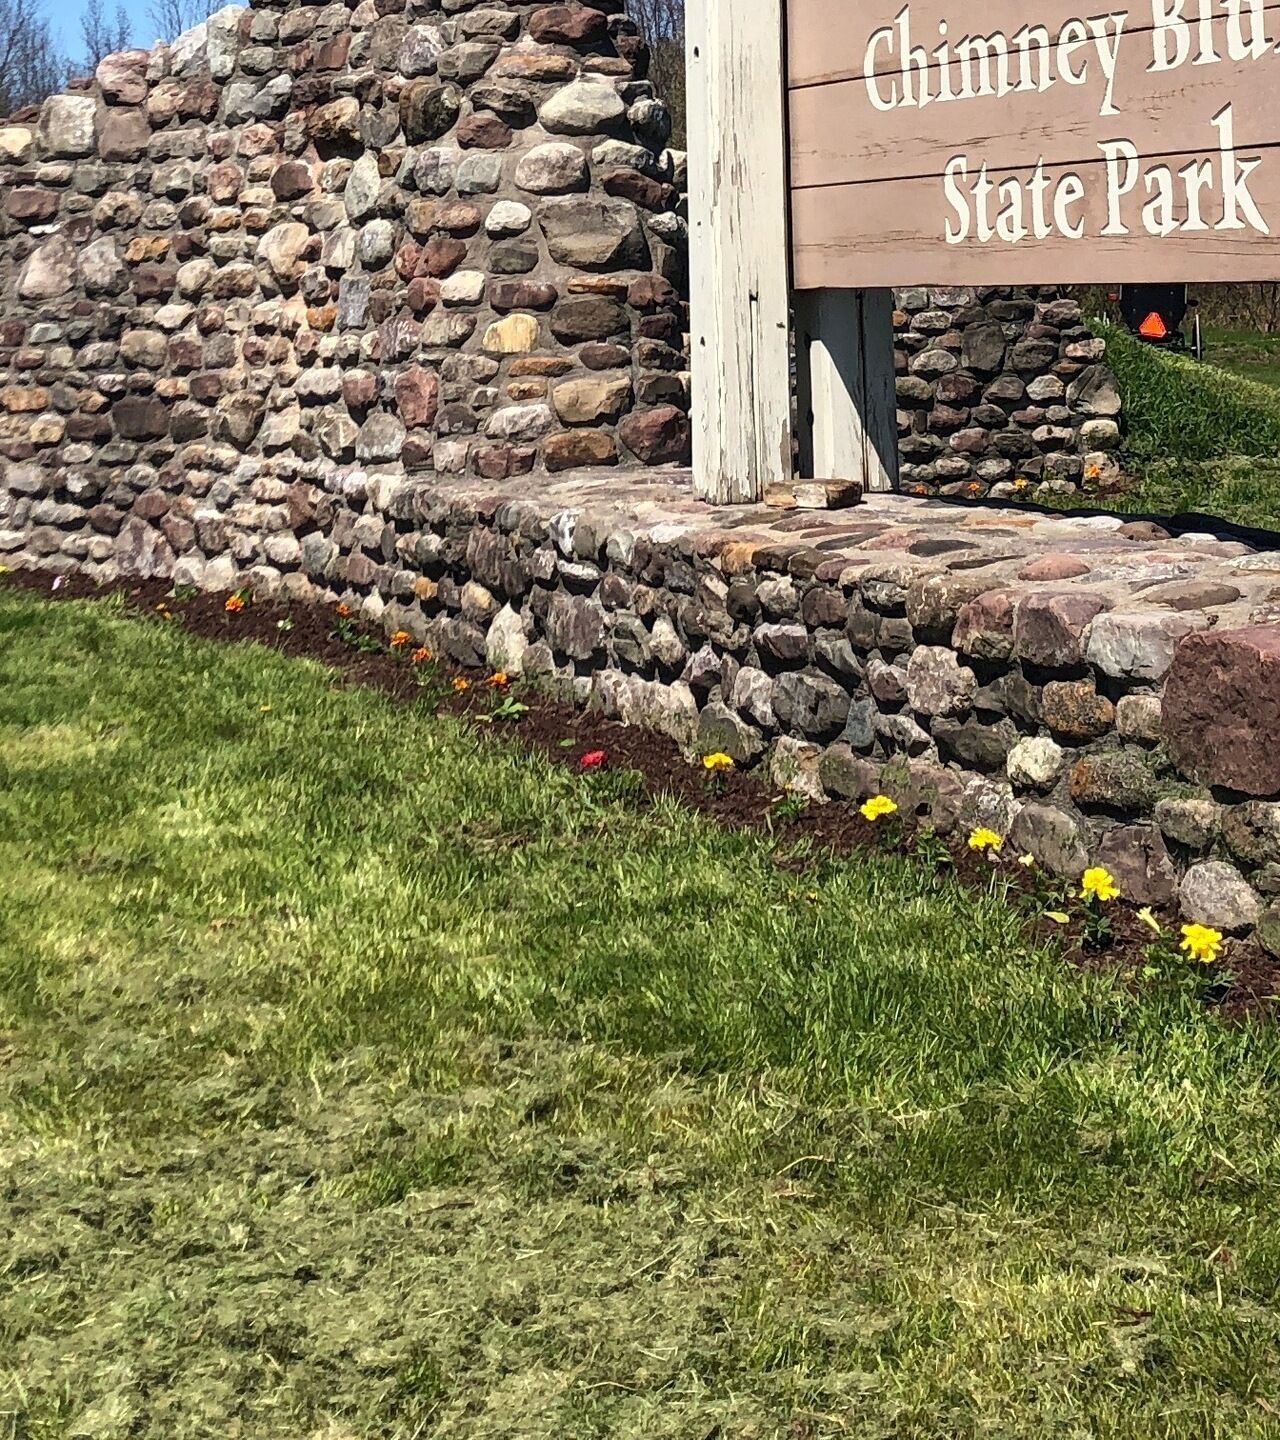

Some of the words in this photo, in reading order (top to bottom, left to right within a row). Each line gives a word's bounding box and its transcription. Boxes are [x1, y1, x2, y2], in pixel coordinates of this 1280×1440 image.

[863, 3, 1128, 116] Chimney
[943, 154, 1085, 245] State
[1096, 101, 1270, 238] Park
